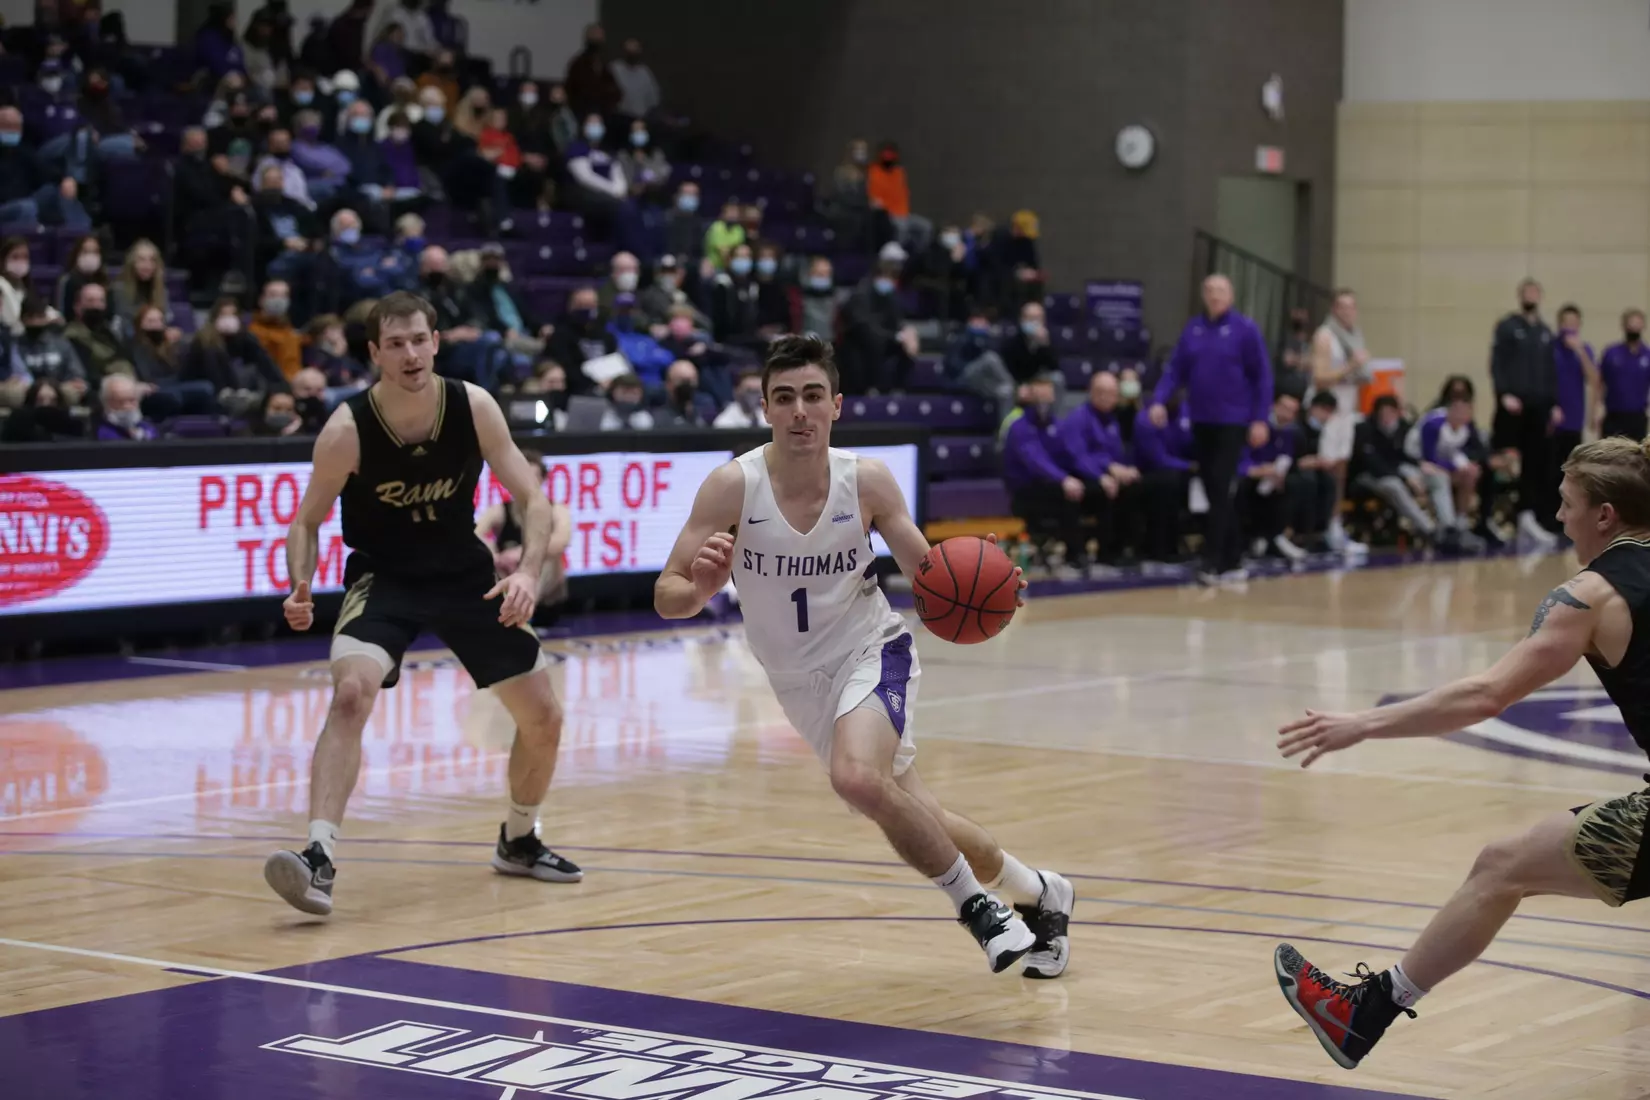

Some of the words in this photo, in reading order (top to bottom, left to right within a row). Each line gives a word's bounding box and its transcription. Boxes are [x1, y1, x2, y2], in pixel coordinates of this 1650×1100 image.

[199, 473, 335, 528] PRO
[622, 461, 672, 510] OF
[743, 548, 768, 577] ST.
[775, 548, 857, 577] THOMAS
[790, 587, 809, 633] 1
